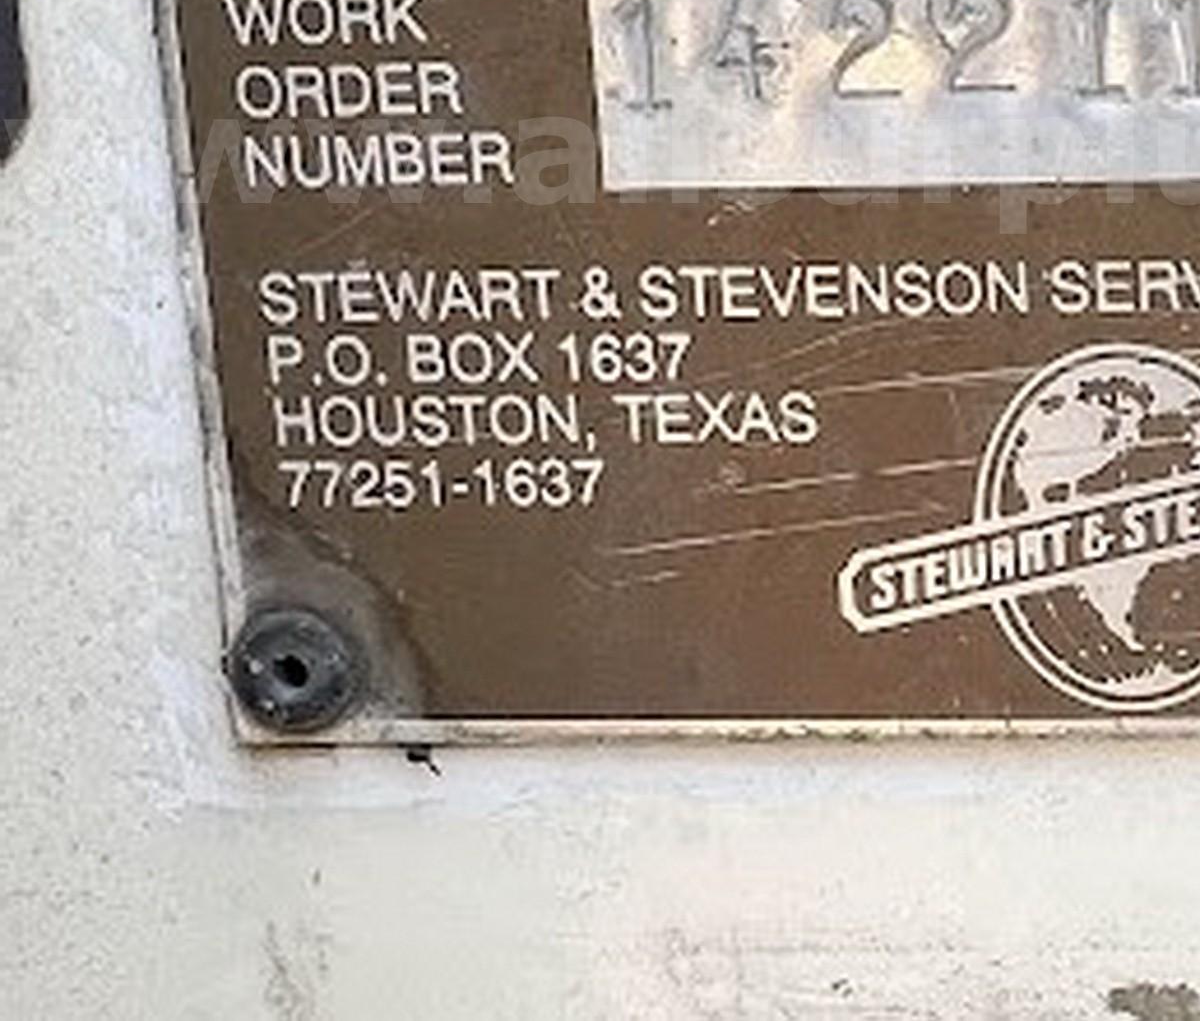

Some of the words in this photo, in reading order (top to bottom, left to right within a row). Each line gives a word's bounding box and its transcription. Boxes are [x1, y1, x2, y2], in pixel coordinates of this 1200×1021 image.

[237, 62, 463, 118] ORDER
[244, 132, 515, 188] NUMBER
[260, 269, 561, 325] STEWART
[580, 267, 622, 320] &
[639, 262, 1029, 318] STEVENSON
[268, 335, 387, 386] P.O.
[407, 331, 539, 384] BOX
[558, 331, 691, 382] 1637
[273, 394, 596, 452] HOUSTON,
[612, 391, 819, 443] TEXAS
[278, 457, 604, 507] 77251-1637
[868, 521, 1075, 610] STEWART
[1081, 508, 1115, 560] &
